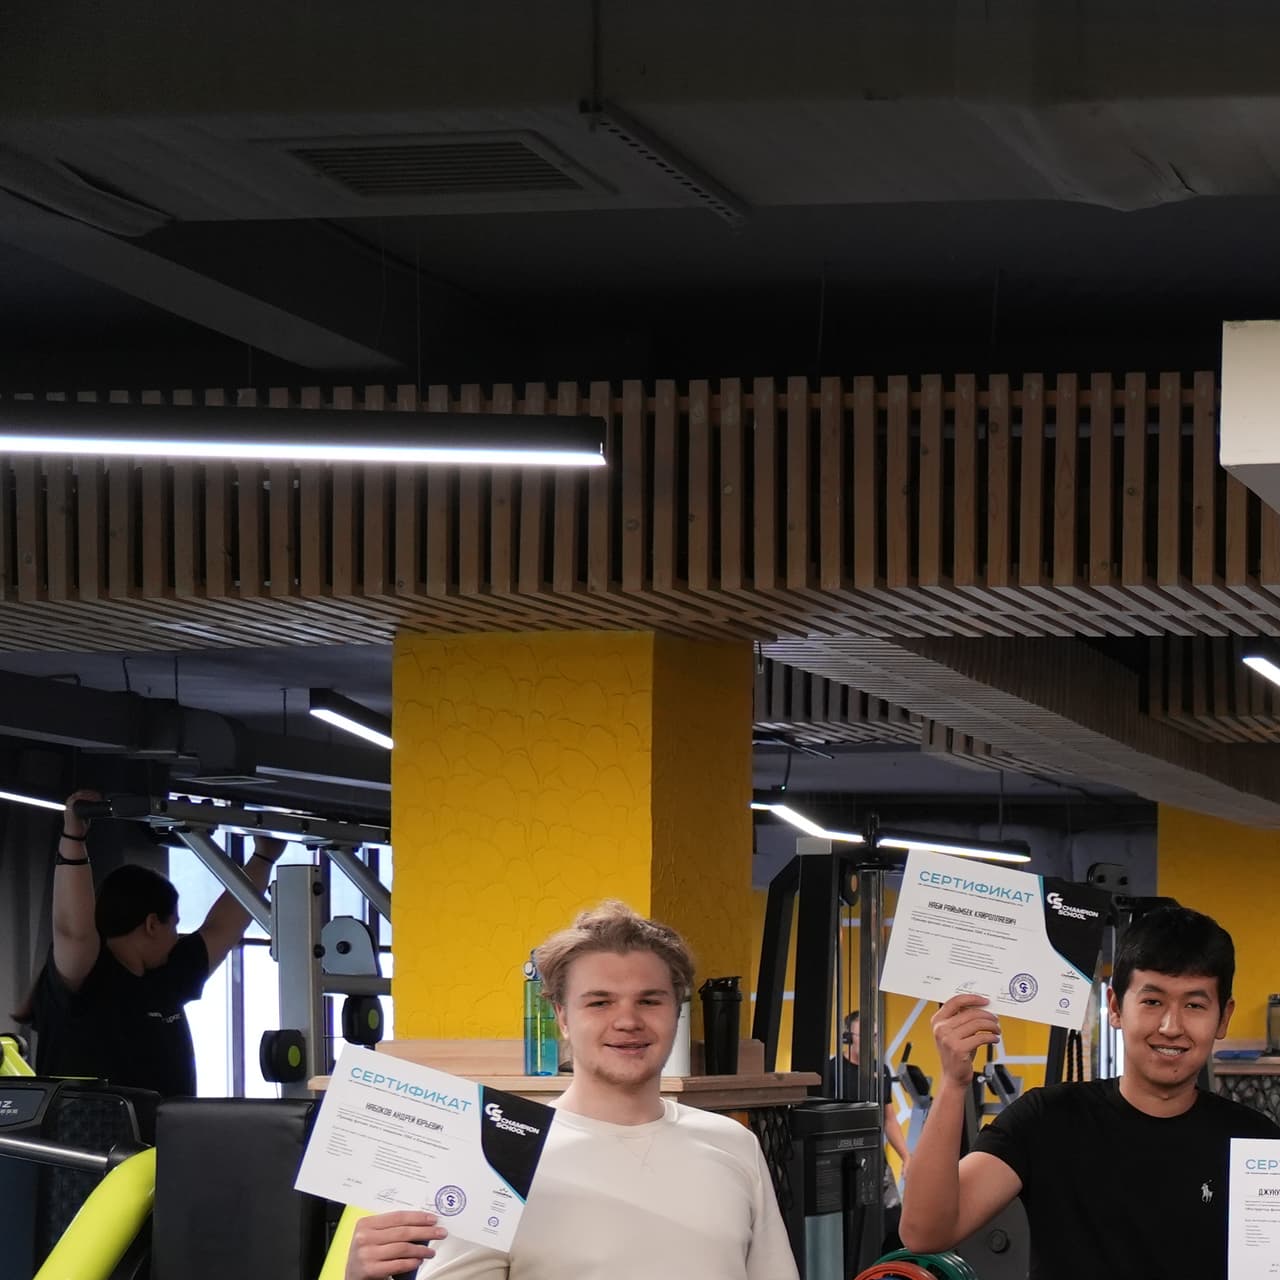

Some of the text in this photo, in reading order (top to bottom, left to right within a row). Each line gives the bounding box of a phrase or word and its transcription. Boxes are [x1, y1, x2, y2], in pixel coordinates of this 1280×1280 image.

[919, 871, 1033, 902] СЕРТИФИКАТ
[1056, 909, 1087, 921] SCHOOL
[1060, 904, 1099, 918] CHAMPION
[351, 1067, 470, 1110] СЕРТИФИКАТ
[494, 1121, 527, 1136] SCHOOL
[499, 1116, 540, 1135] CHAMPION
